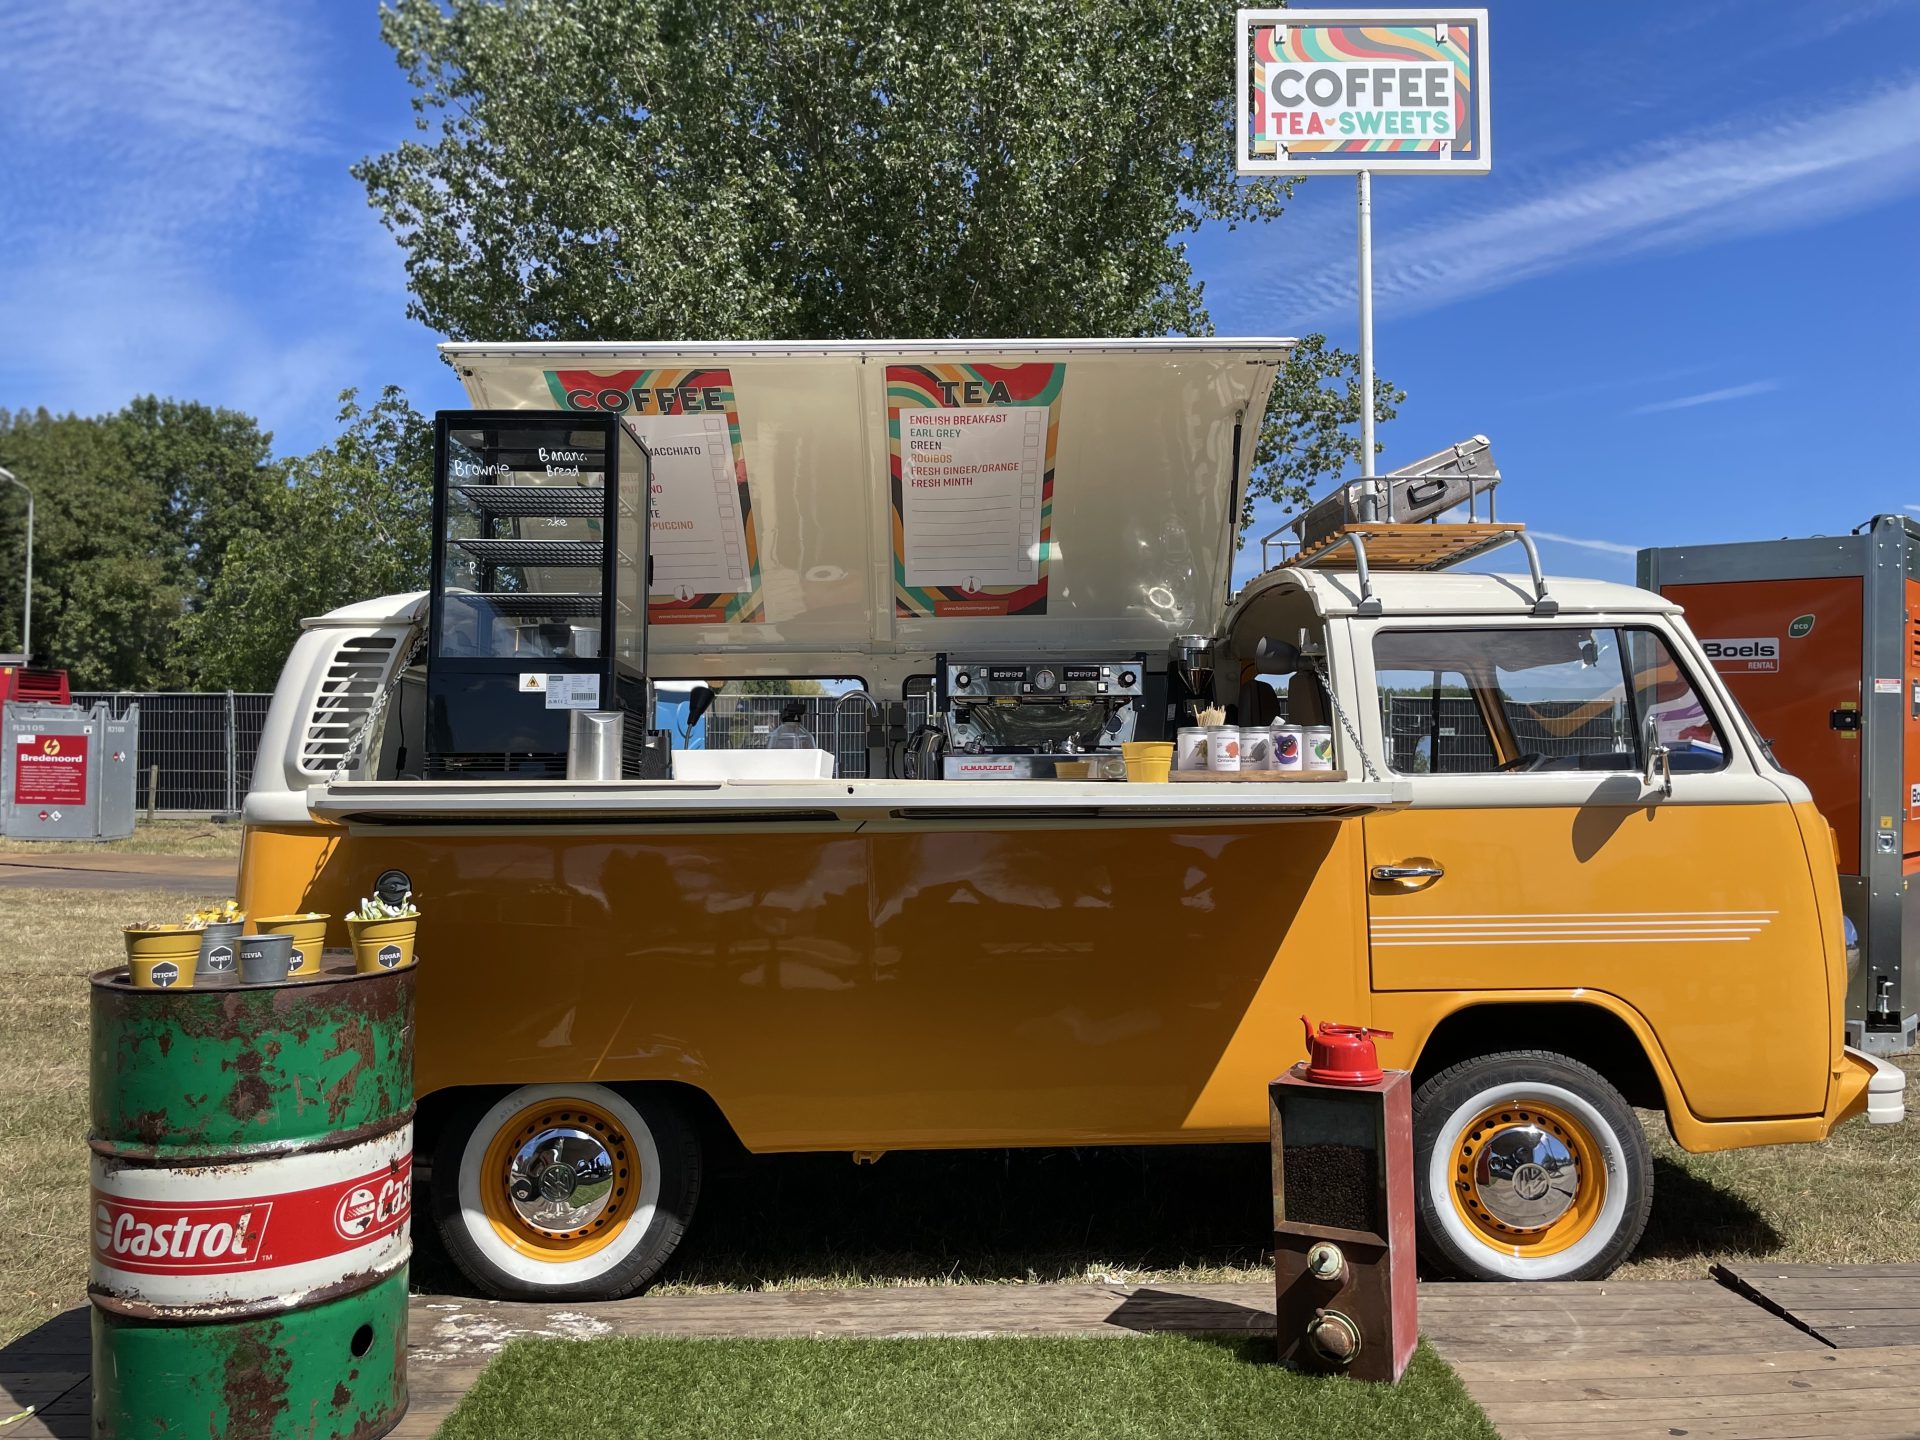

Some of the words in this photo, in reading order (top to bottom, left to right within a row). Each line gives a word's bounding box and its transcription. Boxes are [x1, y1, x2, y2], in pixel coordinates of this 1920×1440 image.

[1271, 68, 1449, 107] COFFEE
[1271, 111, 1325, 135] TEA
[1339, 110, 1450, 135] SWEETS
[936, 380, 1012, 405] TEA
[566, 387, 725, 412] COFFEE
[910, 415, 951, 426] ENGLISH
[953, 413, 1008, 426] BREAKFAST
[910, 428, 935, 438] EARL
[936, 428, 961, 438] GREY
[910, 440, 942, 450] GREEN
[911, 453, 952, 464] ROOIBOS
[454, 460, 513, 477] Brownie
[545, 464, 580, 477] Bread
[911, 466, 941, 476] FRESH
[943, 462, 1020, 476] GINGER/ORANGE
[911, 478, 941, 488] FRESH
[943, 477, 973, 487] MINTH
[1703, 642, 1775, 657] Boels
[1748, 661, 1775, 670] RENTAL
[20, 753, 83, 763] Bredenoord
[380, 952, 401, 961] SUGAR
[152, 971, 177, 979] STICKS
[112, 1210, 250, 1258] Castrol
